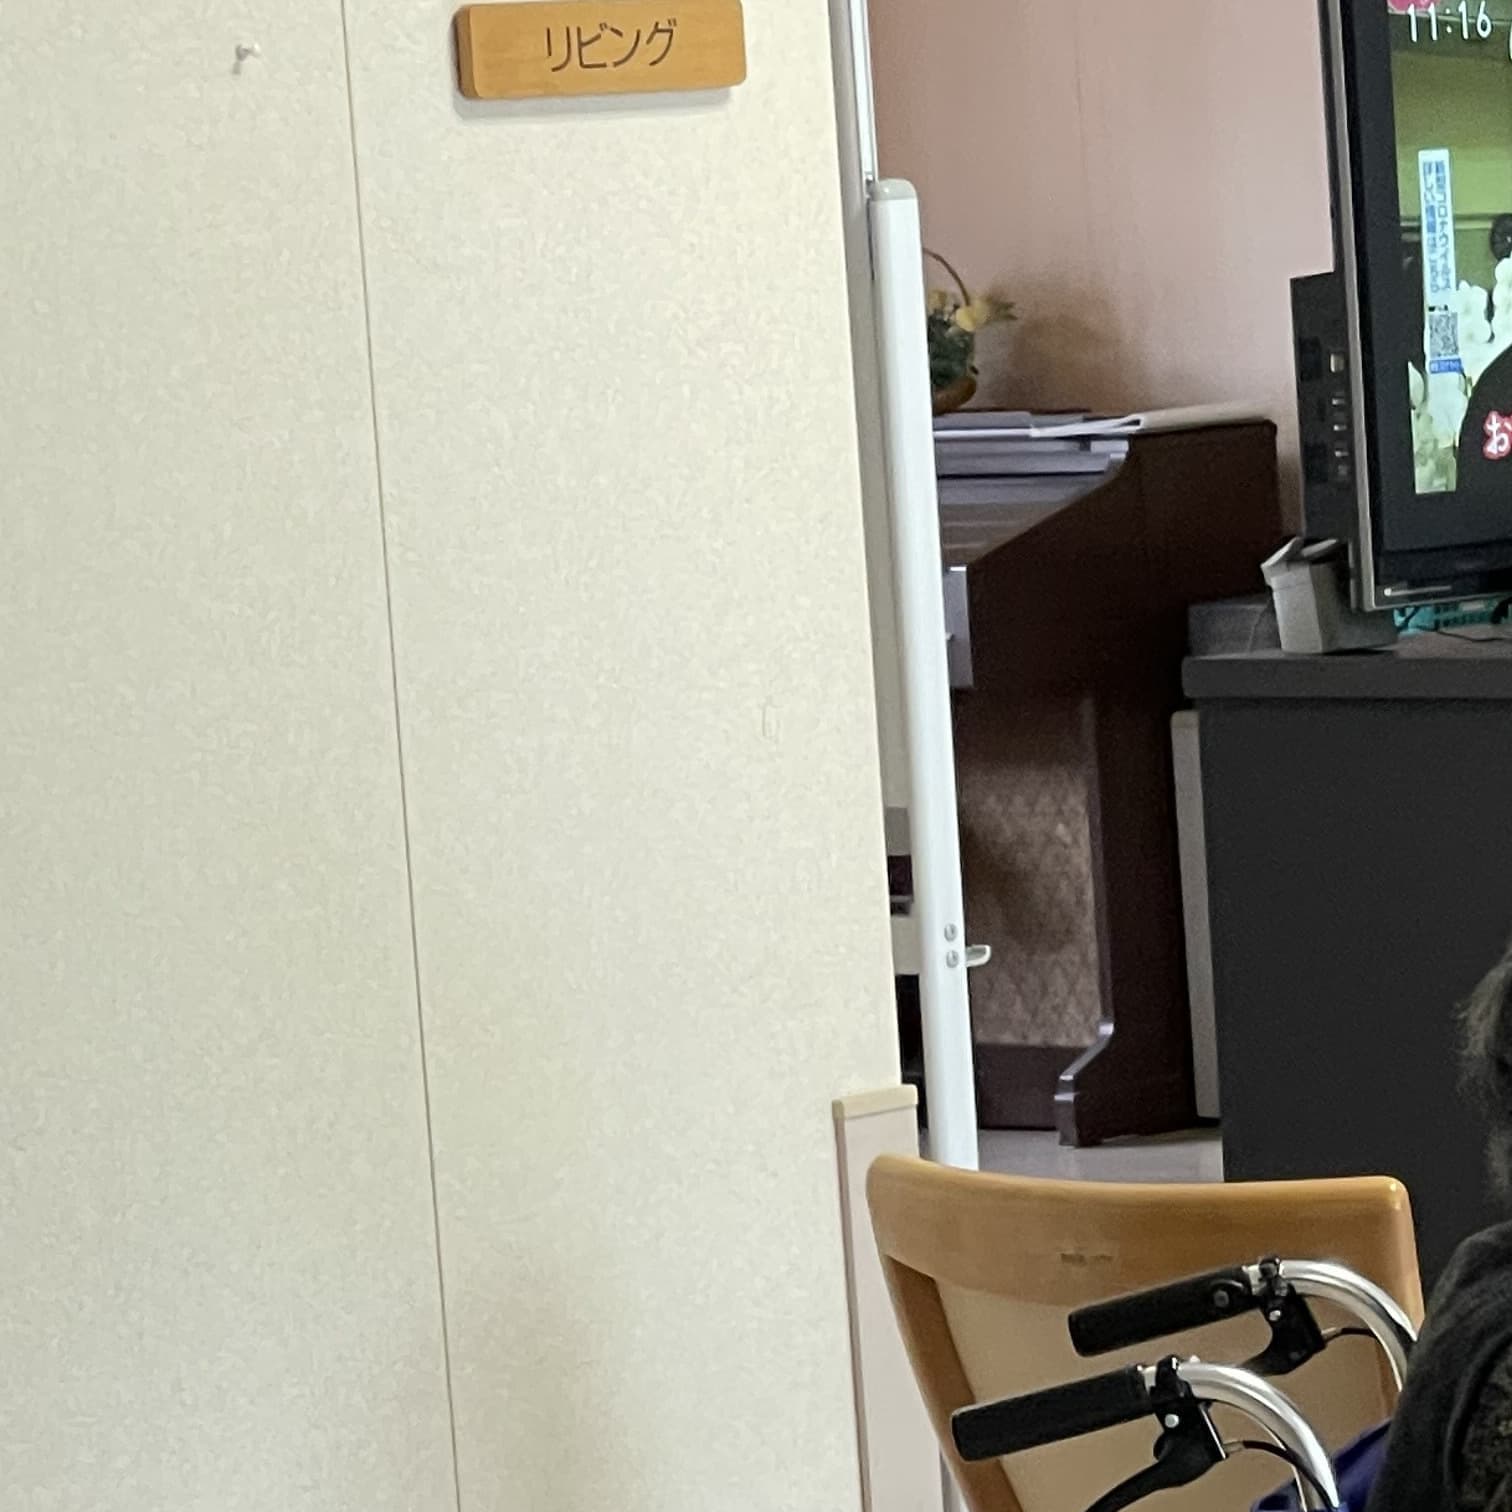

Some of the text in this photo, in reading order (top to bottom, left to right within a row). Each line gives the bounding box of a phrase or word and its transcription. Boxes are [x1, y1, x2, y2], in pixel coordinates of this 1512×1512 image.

[1407, 0, 1492, 42] 11:16
[546, 18, 677, 73] リビング
